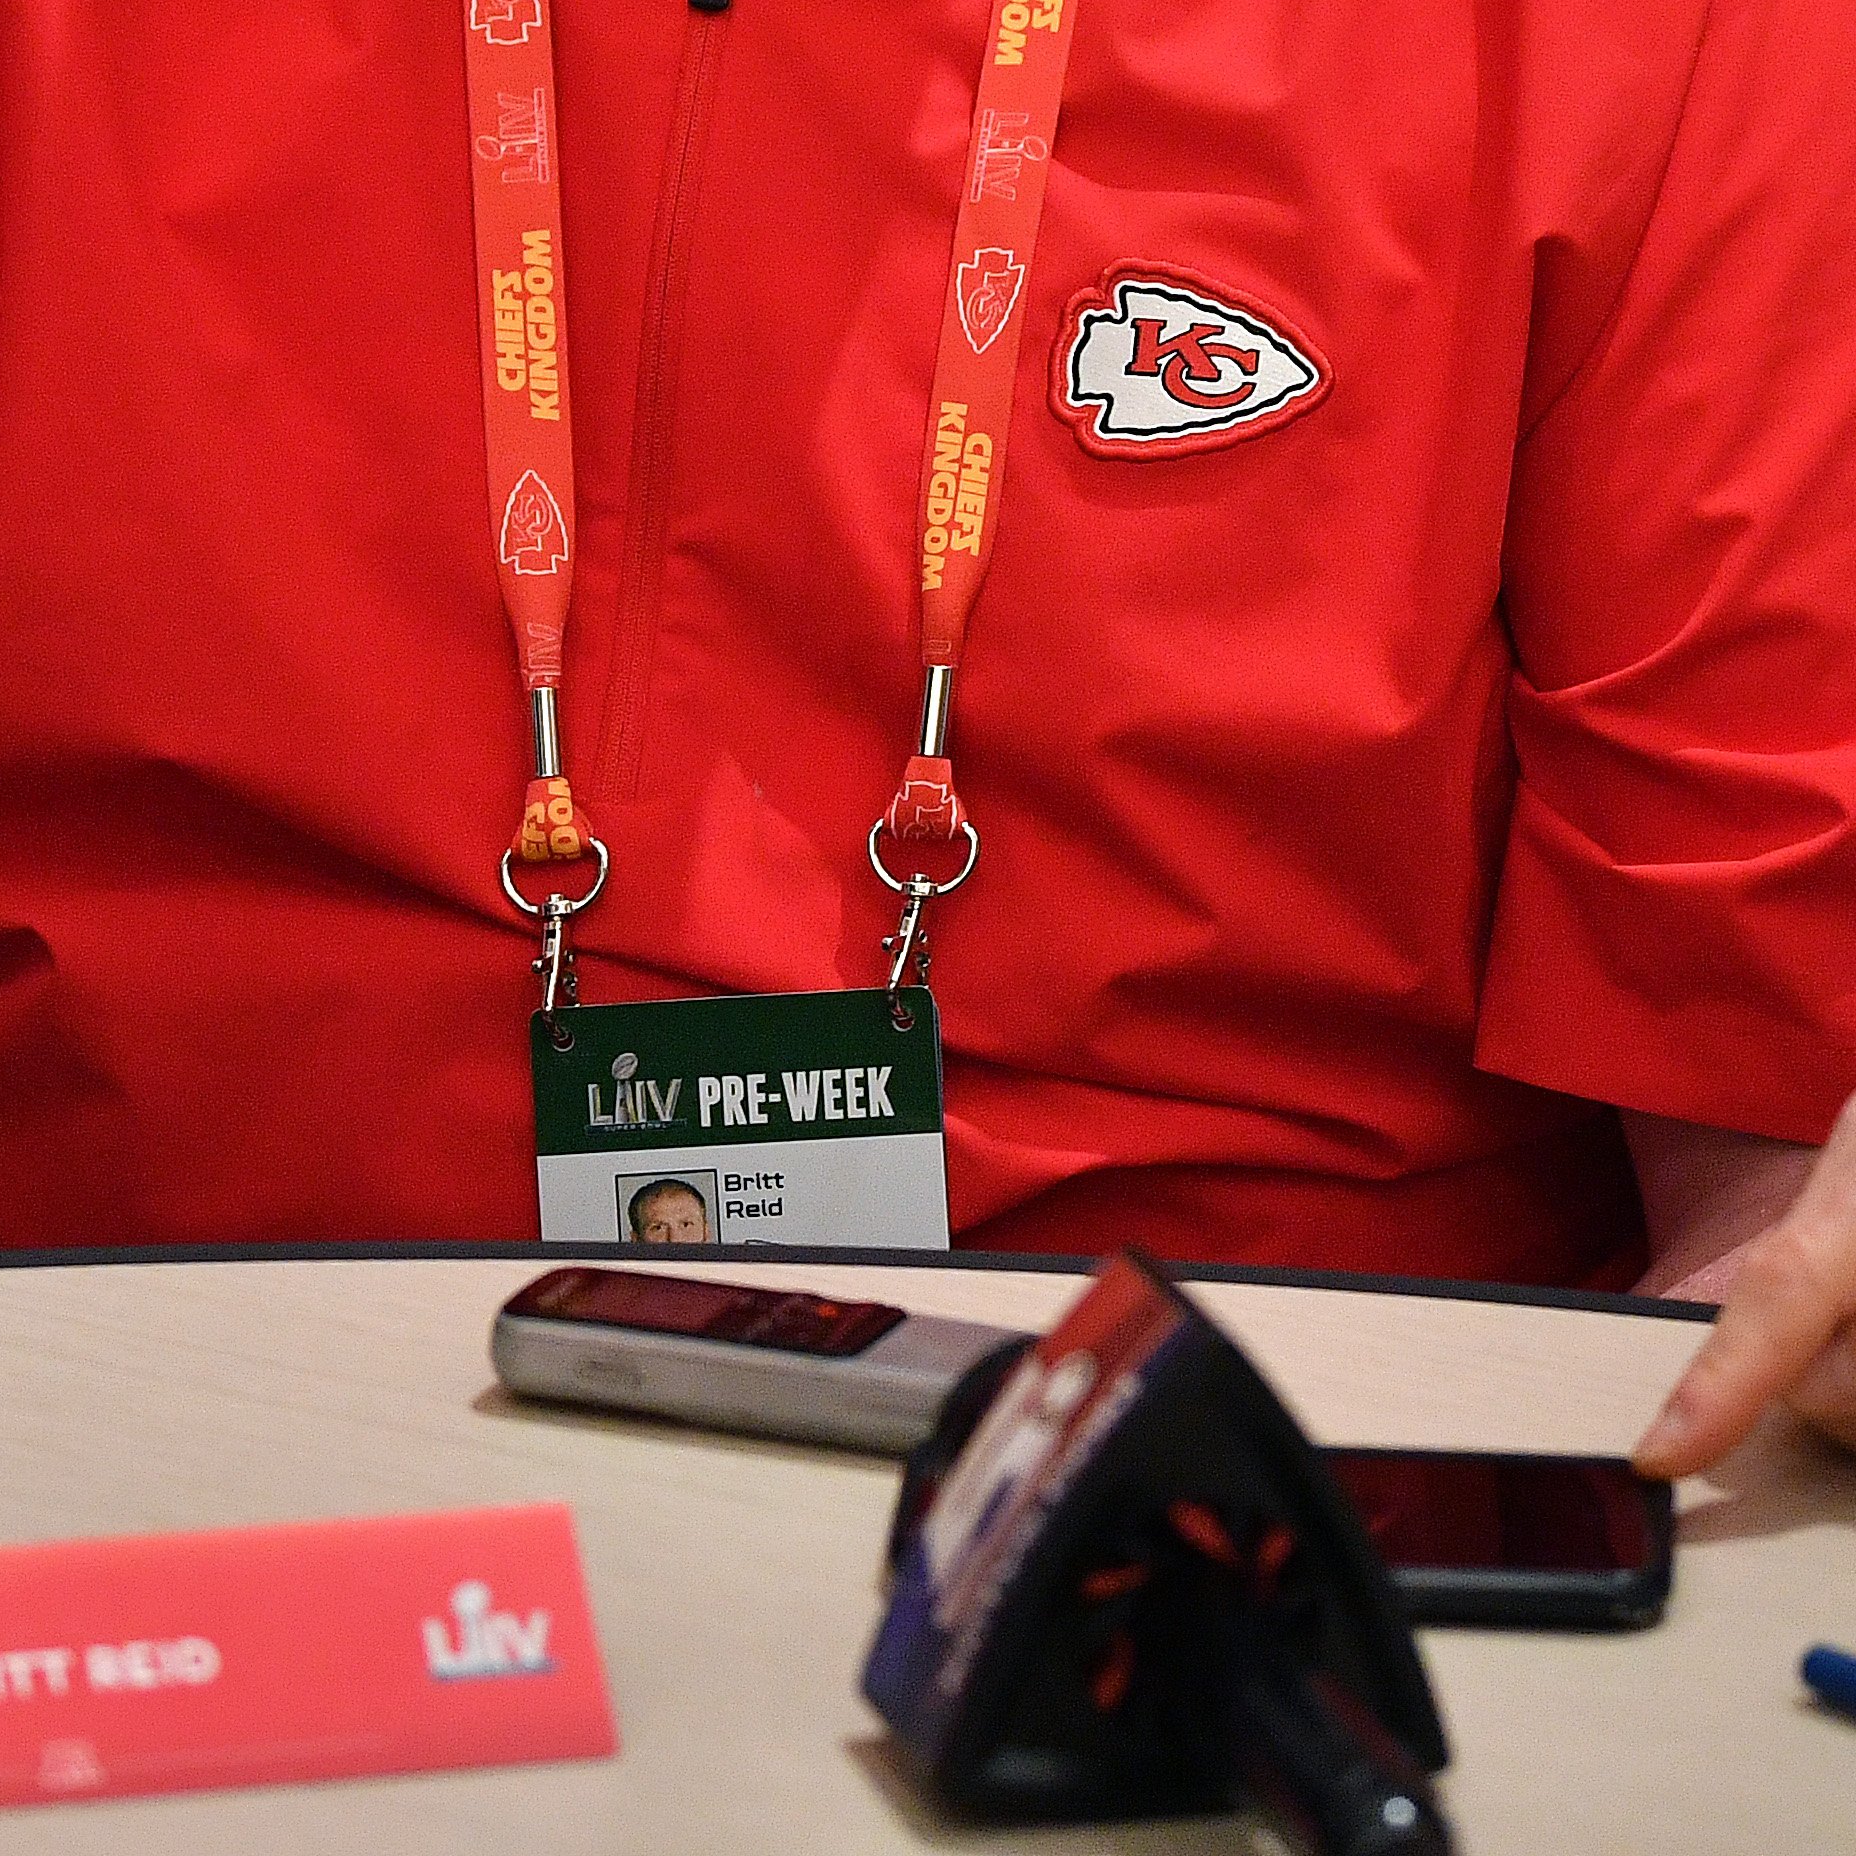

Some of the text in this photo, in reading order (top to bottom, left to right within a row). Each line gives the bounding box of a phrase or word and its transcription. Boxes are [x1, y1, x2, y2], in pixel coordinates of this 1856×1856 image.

[492, 268, 526, 392] CHIEFS
[521, 229, 560, 421] KINGDOM
[1124, 318, 1260, 409] KC
[922, 401, 968, 592] KINGDOM
[950, 432, 993, 556] CHIEFS
[698, 1066, 894, 1128] PRE-WEEK
[724, 1172, 785, 1192] Britt
[725, 1197, 783, 1219] Reid
[84, 1635, 223, 1689] REID
